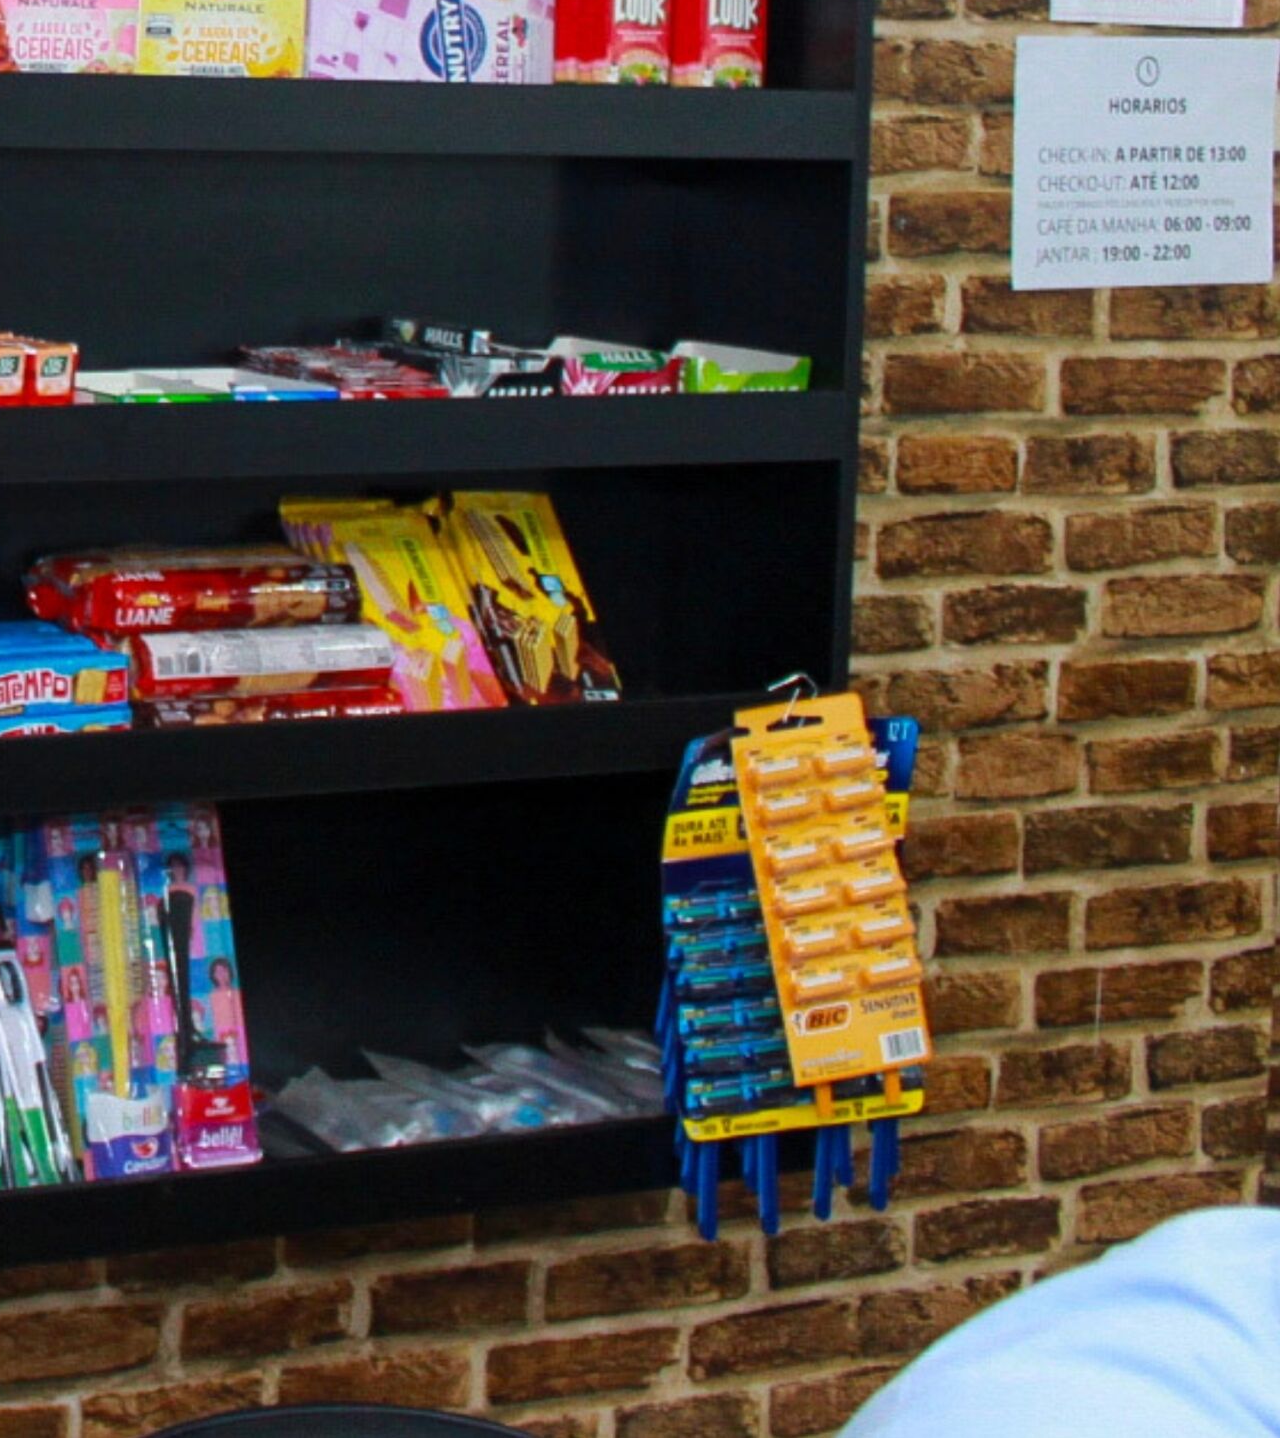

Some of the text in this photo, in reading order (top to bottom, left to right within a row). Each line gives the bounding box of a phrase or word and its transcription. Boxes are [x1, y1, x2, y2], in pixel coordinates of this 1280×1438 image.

[185, 0, 265, 15] NATURALE
[15, 36, 95, 63] CEREAIS
[181, 40, 261, 64] CEREAIS
[495, 16, 512, 84] EREAL
[1109, 98, 1187, 115] HORARIOS
[1115, 147, 1125, 162] A
[1130, 147, 1182, 162] PARTIR
[1186, 147, 1204, 162] DE
[1210, 146, 1247, 162] 13:00
[1130, 171, 1158, 191] ATÉ
[1163, 174, 1200, 190] 12:00
[1037, 215, 1073, 236] CAFÉ
[1077, 220, 1097, 235] DA
[1164, 216, 1203, 232] 06:00
[1214, 215, 1252, 231] 09:00
[1102, 245, 1141, 261] 19:00
[1153, 244, 1192, 261] 22:00
[422, 326, 464, 348] HALLS
[115, 607, 175, 628] LIANE
